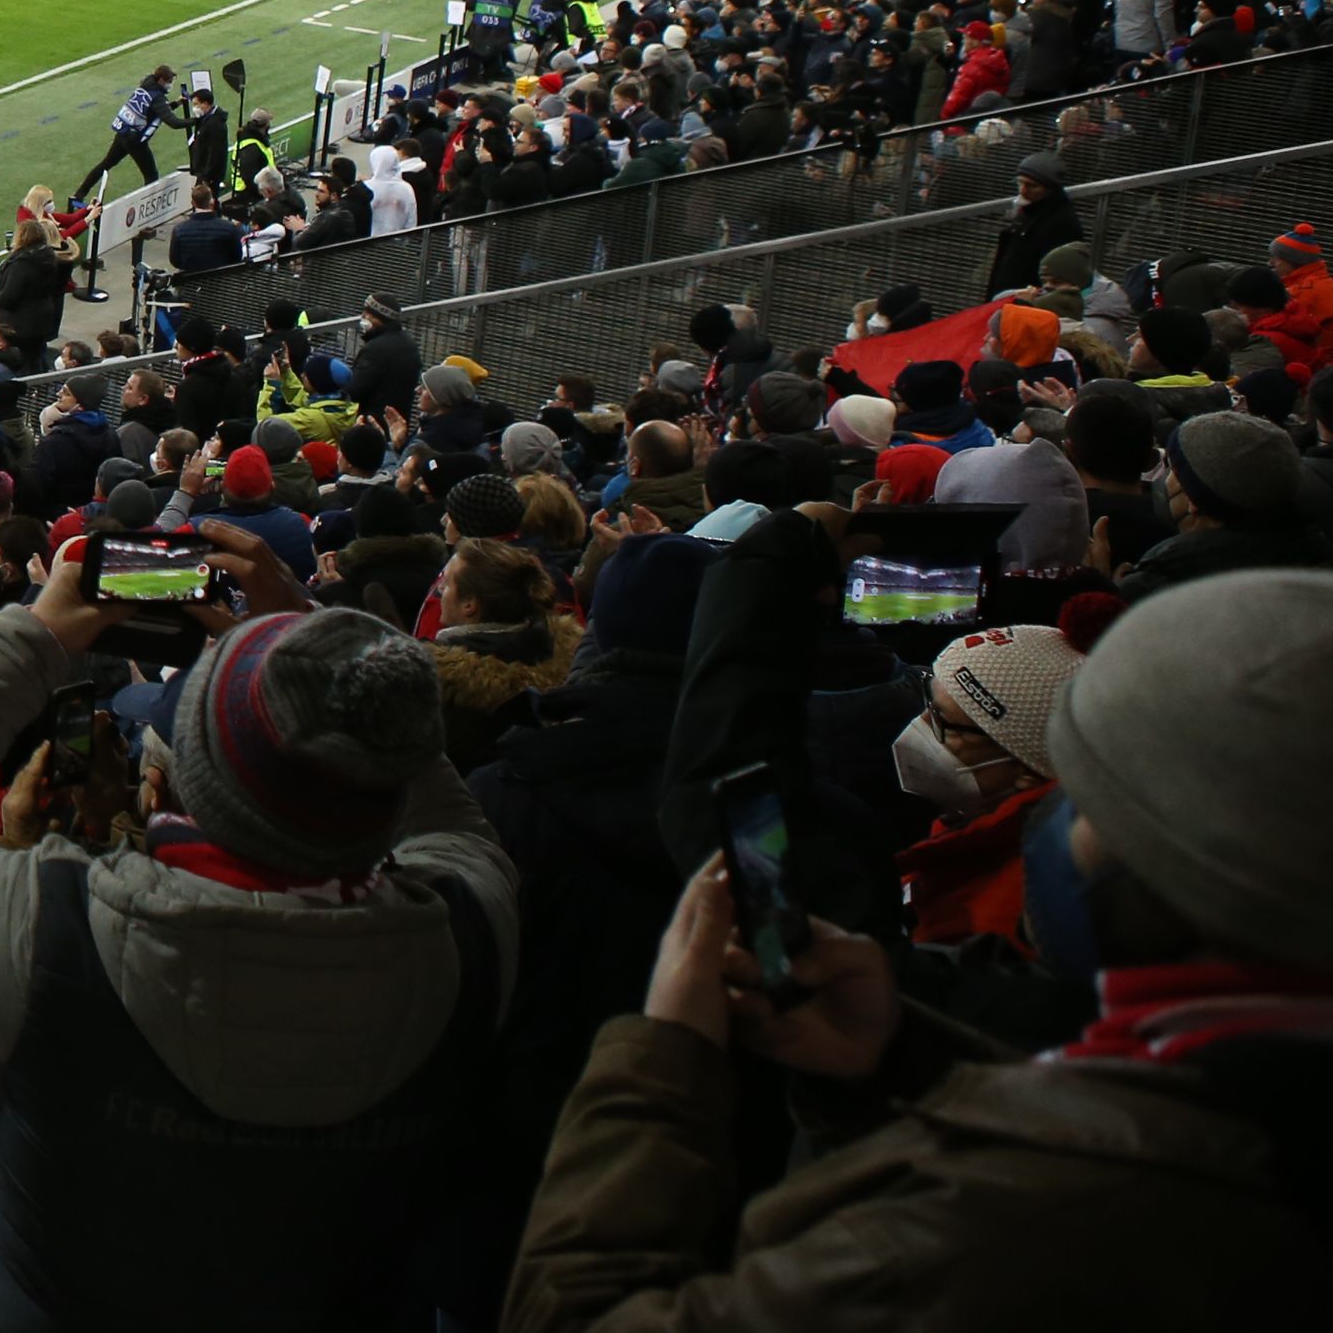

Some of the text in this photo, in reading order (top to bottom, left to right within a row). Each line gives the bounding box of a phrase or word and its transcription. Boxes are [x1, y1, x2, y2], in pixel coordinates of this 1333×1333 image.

[485, 6, 500, 14] TV
[138, 188, 180, 220] RESPECT
[955, 669, 1001, 718] Eisbär
